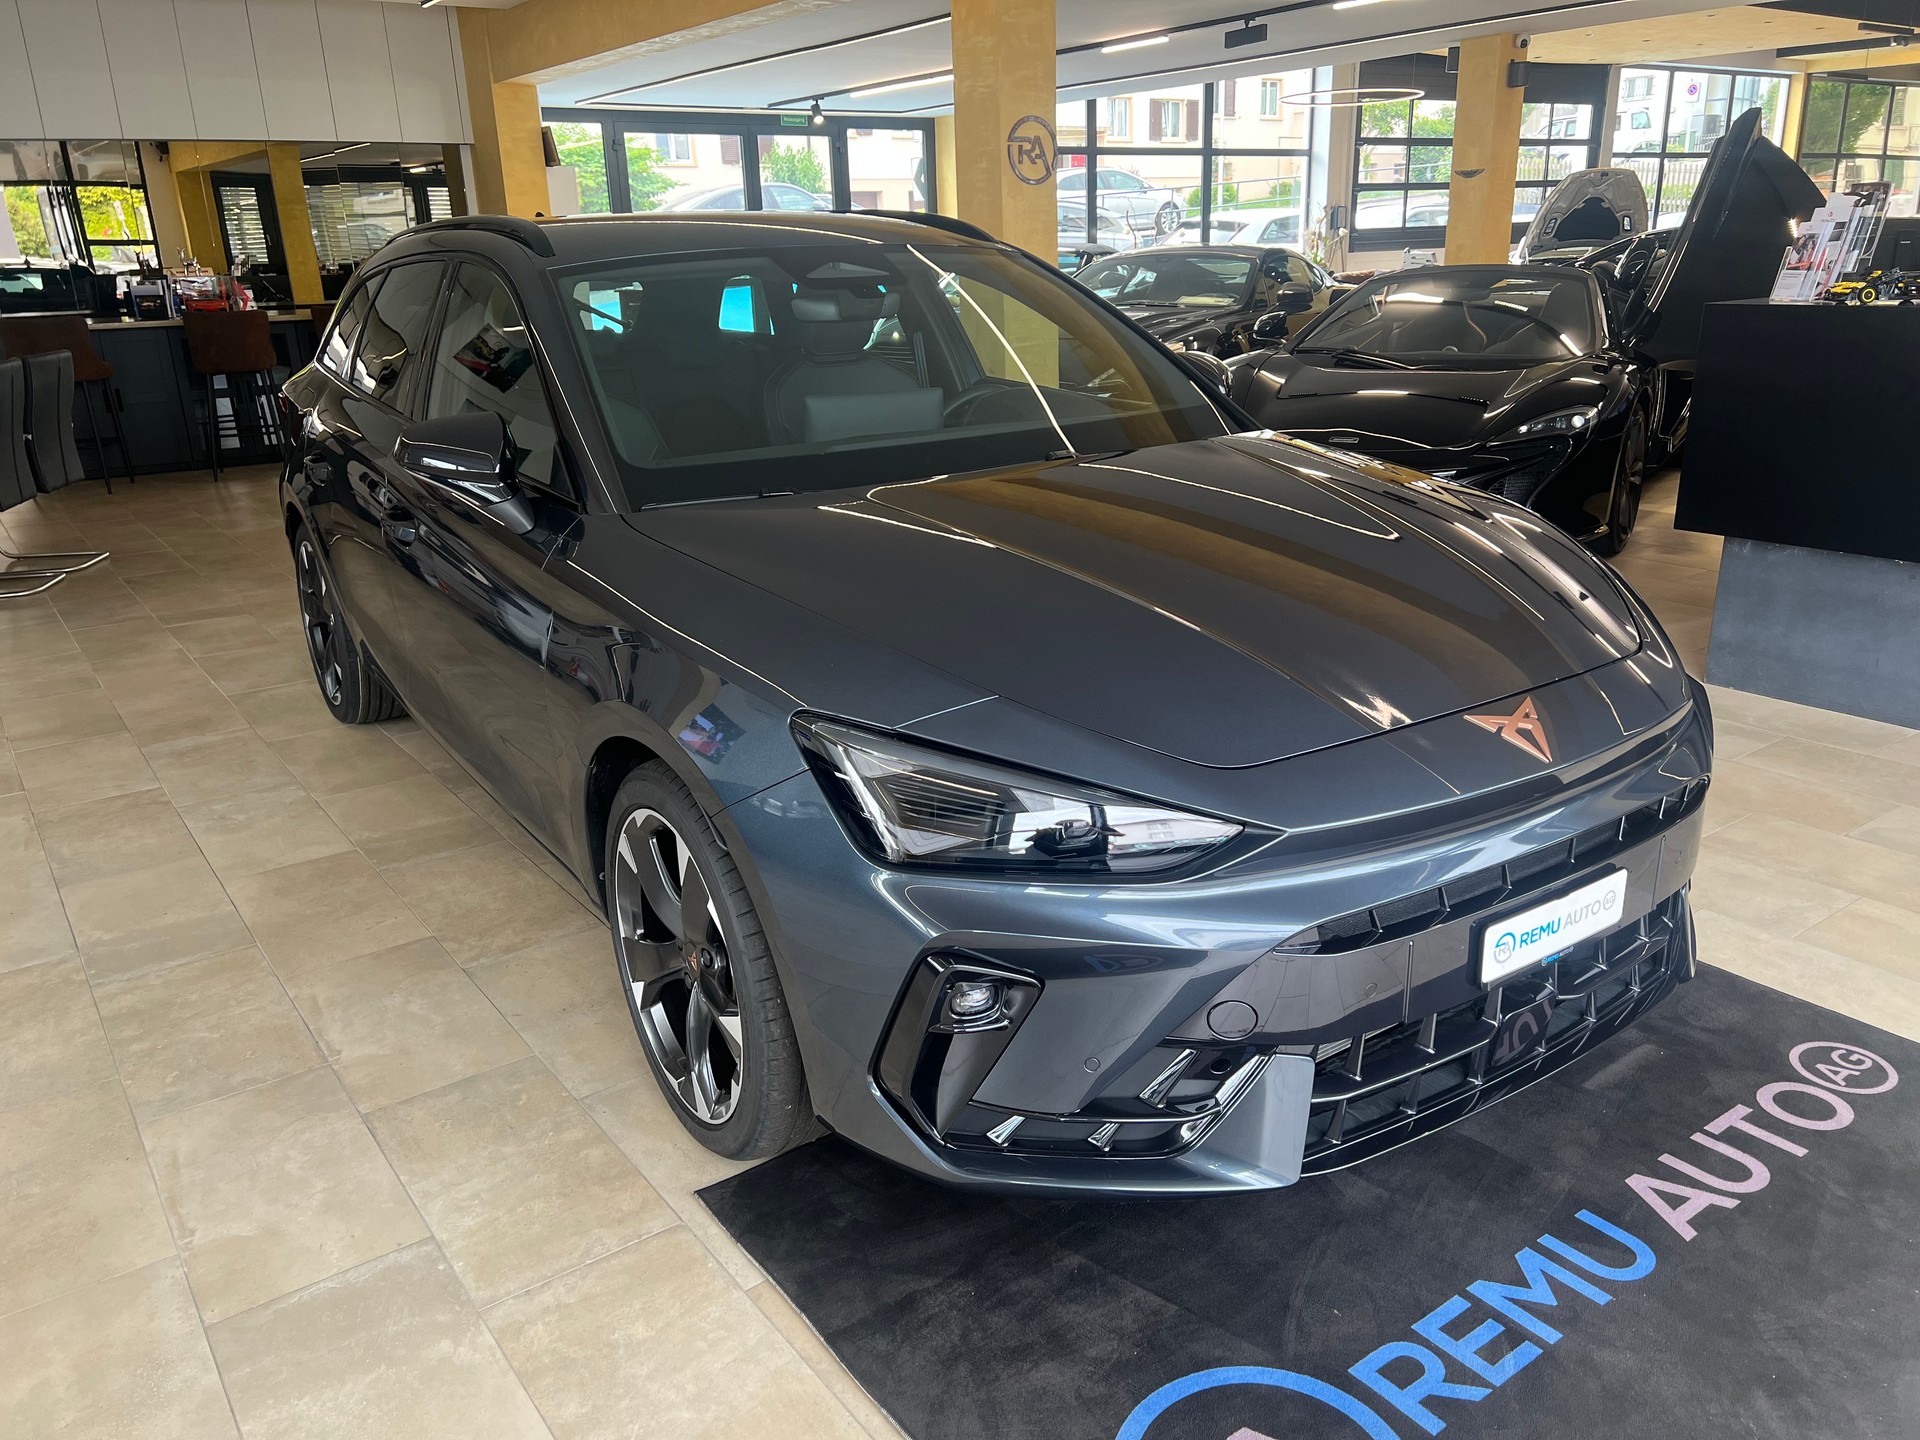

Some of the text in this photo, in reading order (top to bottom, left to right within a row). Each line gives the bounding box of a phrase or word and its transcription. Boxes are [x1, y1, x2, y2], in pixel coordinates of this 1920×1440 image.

[1519, 917, 1561, 949] REMU
[1562, 900, 1602, 930] AUTO
[1347, 1049, 1873, 1437] REMU AUTO AG
